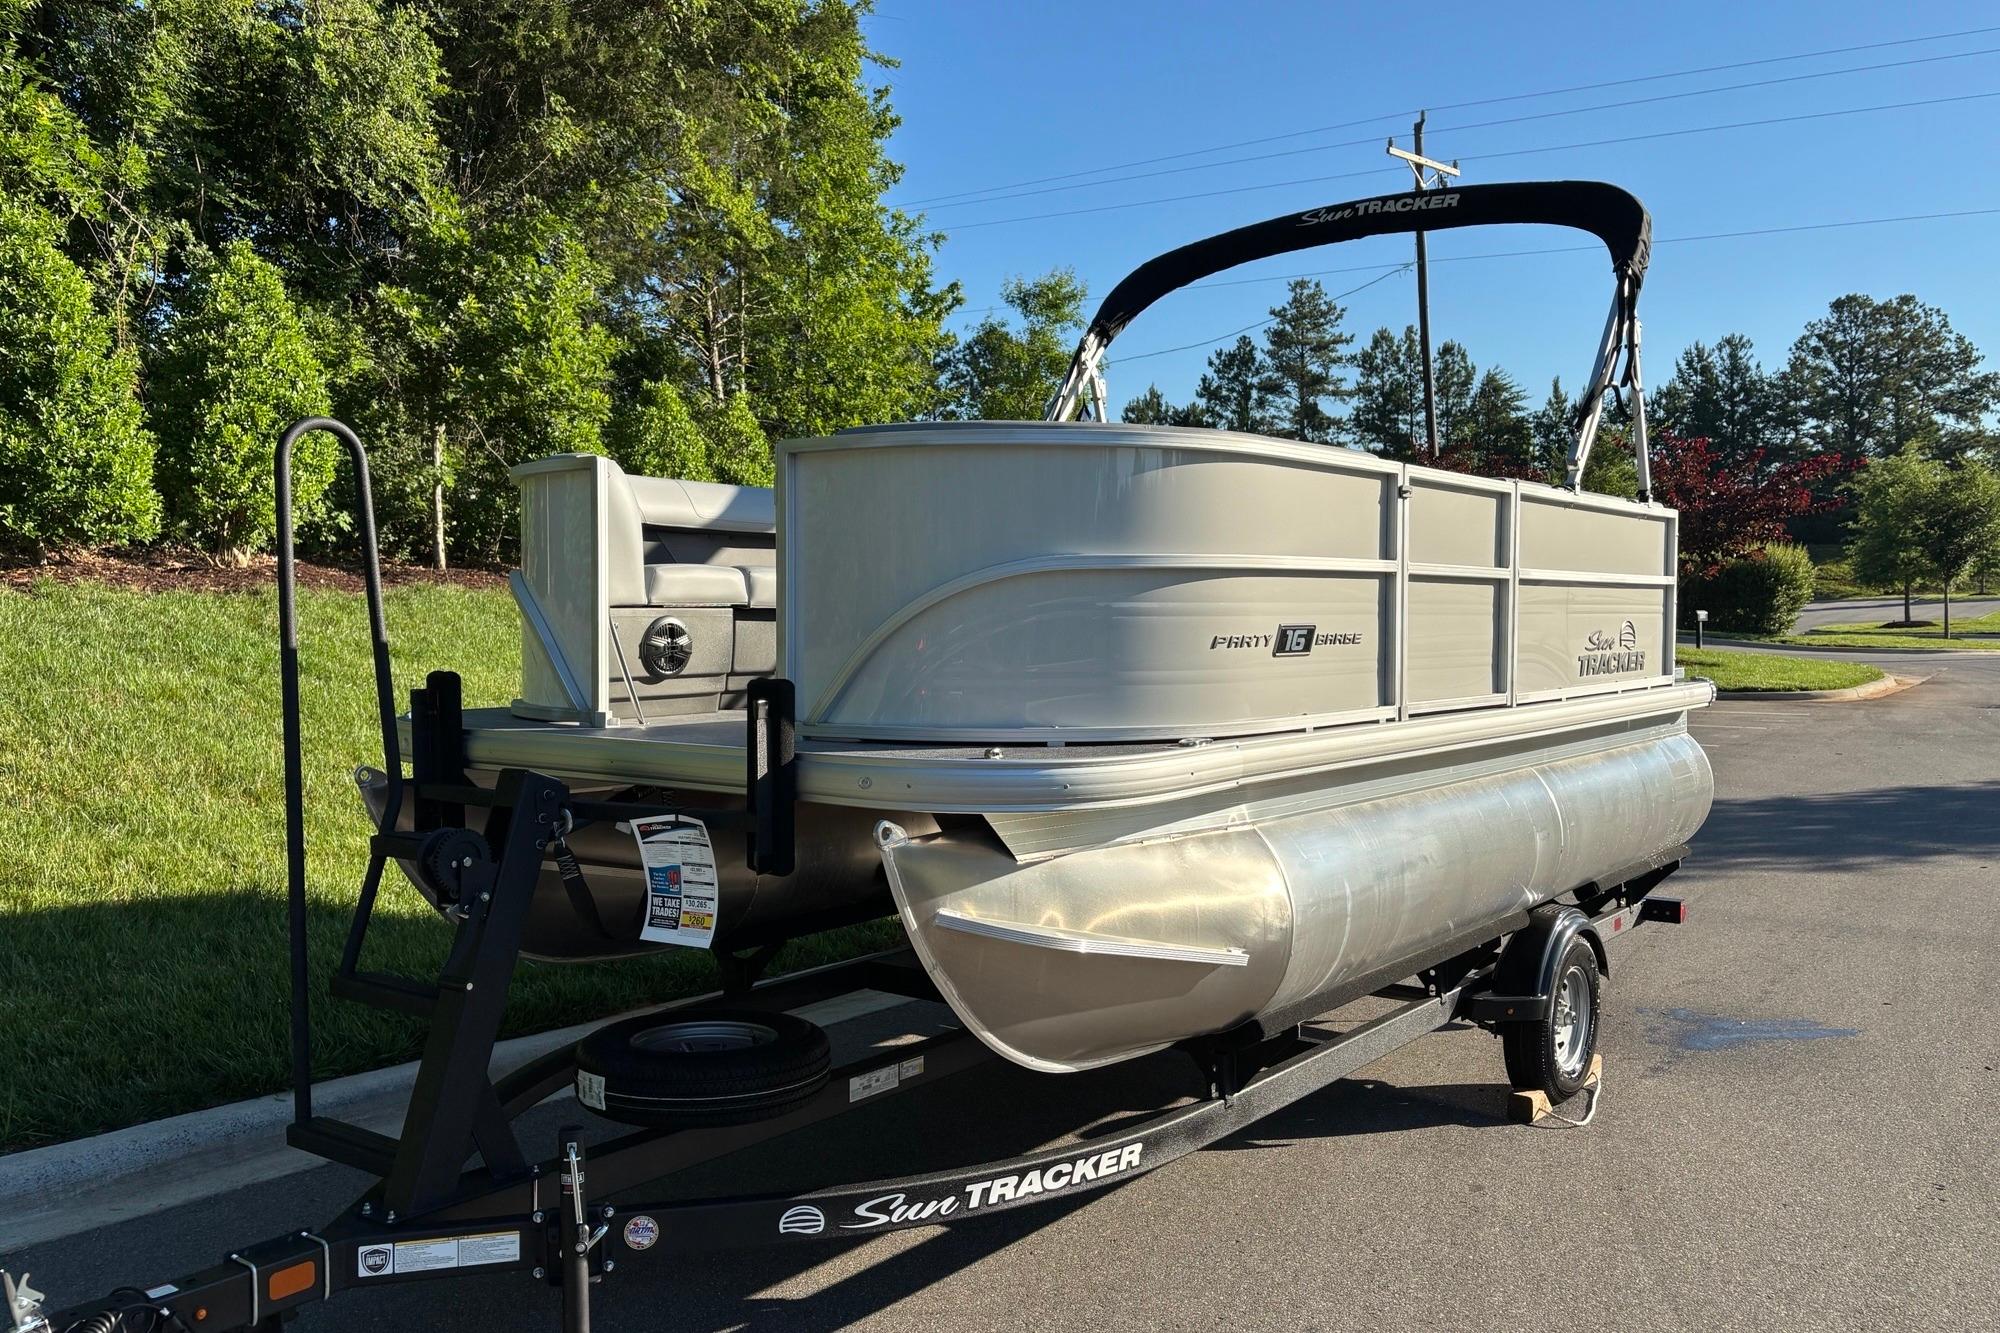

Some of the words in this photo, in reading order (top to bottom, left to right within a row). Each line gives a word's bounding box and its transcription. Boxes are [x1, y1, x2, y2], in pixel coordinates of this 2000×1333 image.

[1296, 208, 1354, 227] Sun
[1355, 193, 1461, 216] TRACKER
[1209, 633, 1273, 650] PARTY
[1285, 629, 1308, 651] 16
[1314, 633, 1363, 646] BARGE
[1584, 629, 1616, 652] Sun
[1577, 651, 1646, 677] TRACKER
[652, 896, 663, 907] WE
[664, 898, 681, 908] TAKE
[652, 906, 680, 918] TRADES!
[840, 1193, 960, 1229] Sun
[965, 1142, 1143, 1209] TRACKER
[365, 1254, 386, 1266] IMPACT
